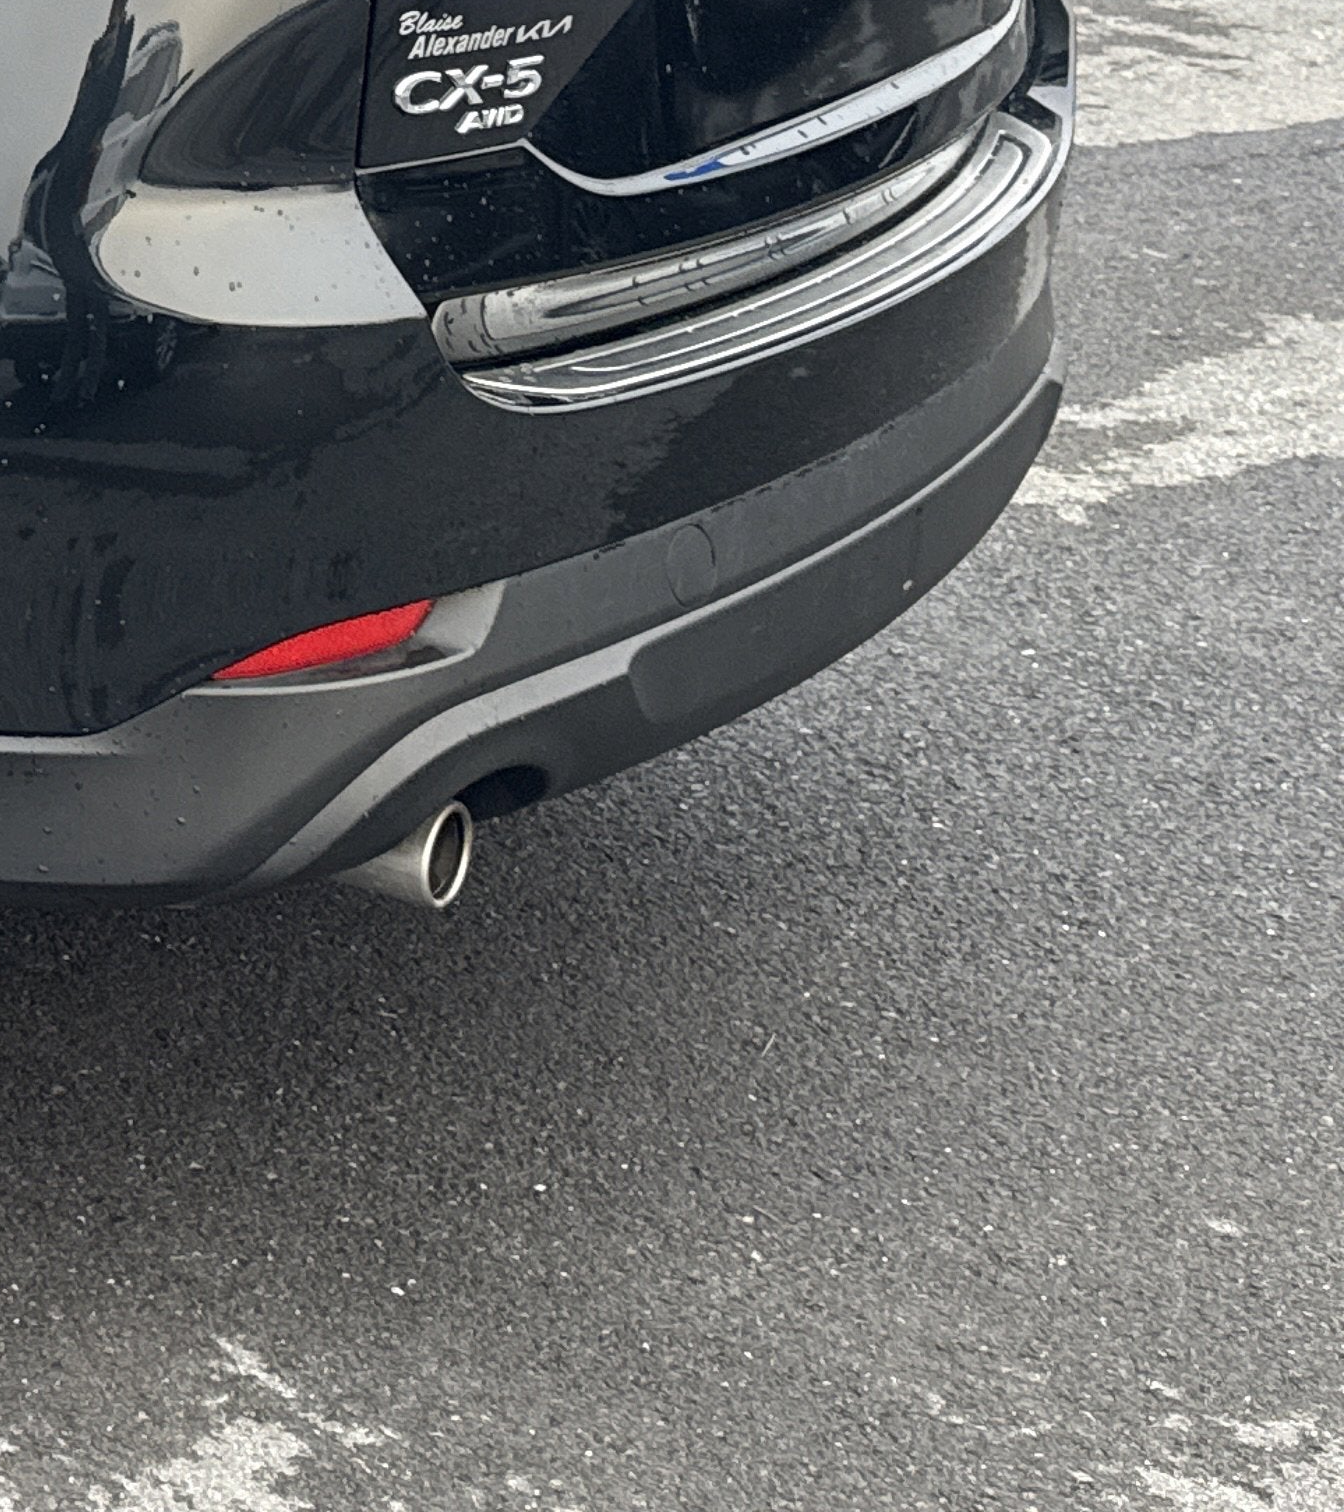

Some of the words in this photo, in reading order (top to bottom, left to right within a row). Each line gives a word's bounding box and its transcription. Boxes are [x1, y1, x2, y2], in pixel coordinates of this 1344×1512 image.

[399, 10, 463, 36] Blaise
[407, 25, 515, 59] Alexander
[394, 55, 544, 114] CX-5
[455, 104, 524, 134] AWD
